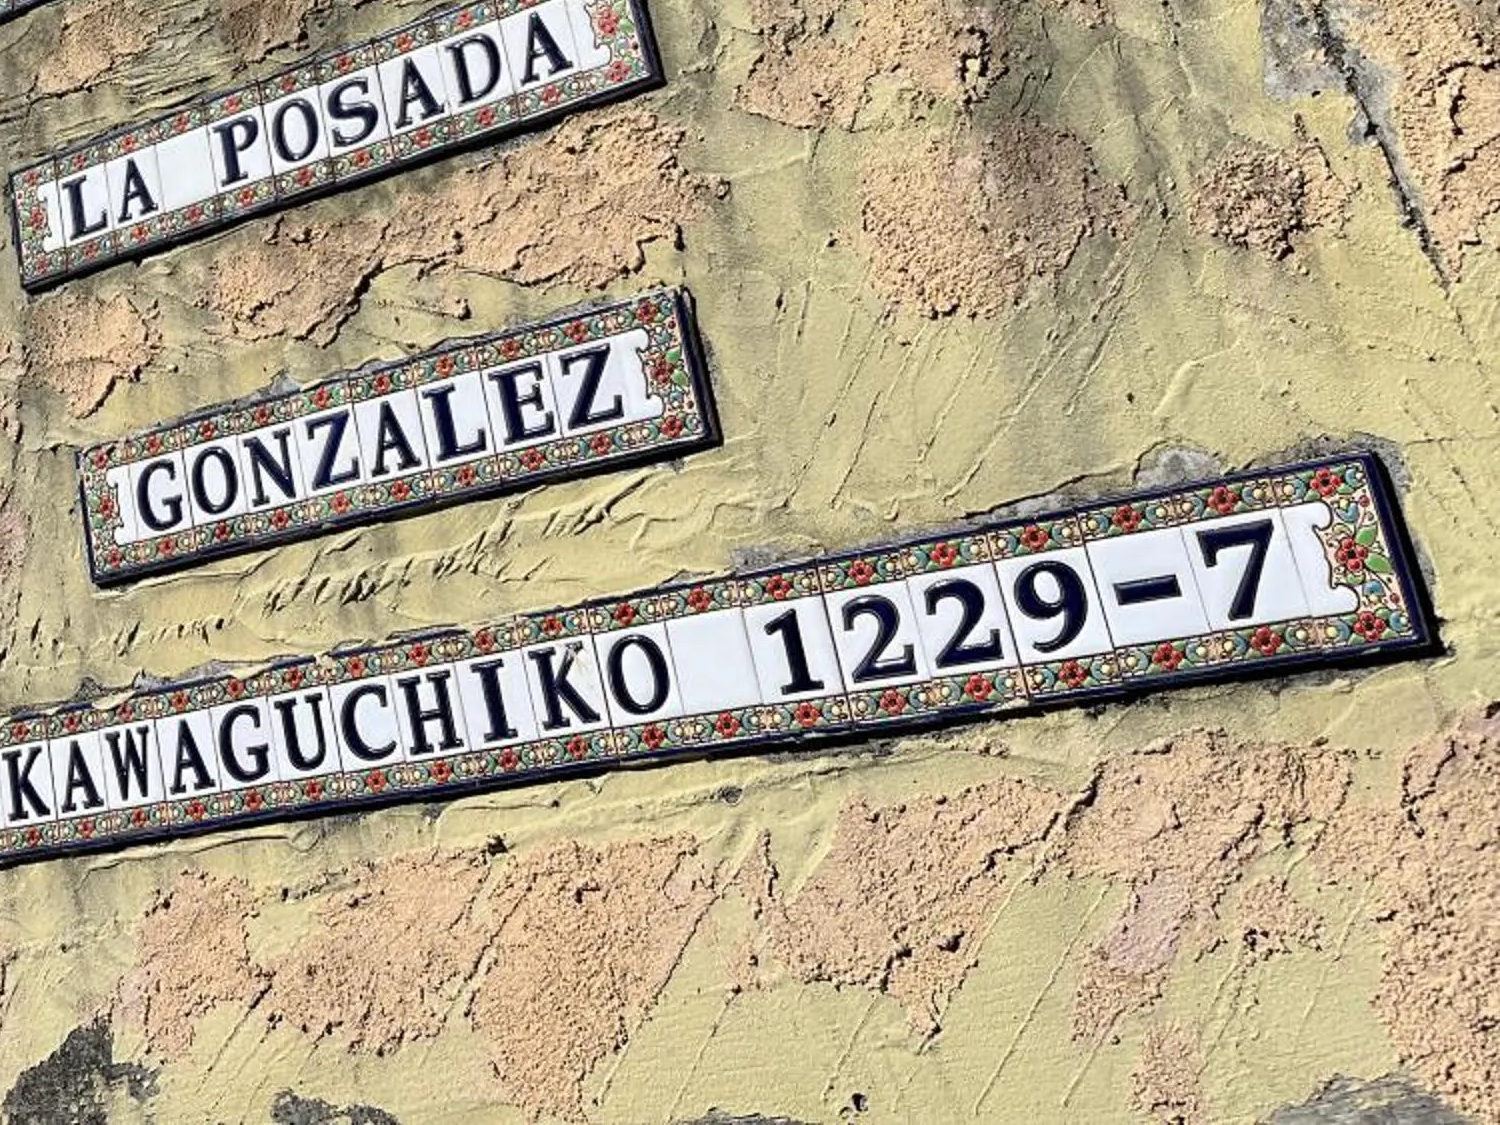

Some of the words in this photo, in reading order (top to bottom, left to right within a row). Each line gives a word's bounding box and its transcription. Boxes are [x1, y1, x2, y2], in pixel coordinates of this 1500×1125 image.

[61, 158, 160, 241] LA
[211, 12, 574, 187] POSADA
[135, 344, 625, 532] GONZALEZ
[2, 634, 671, 823] KAWAGUCHIKO
[763, 519, 1275, 696] 1229-7
